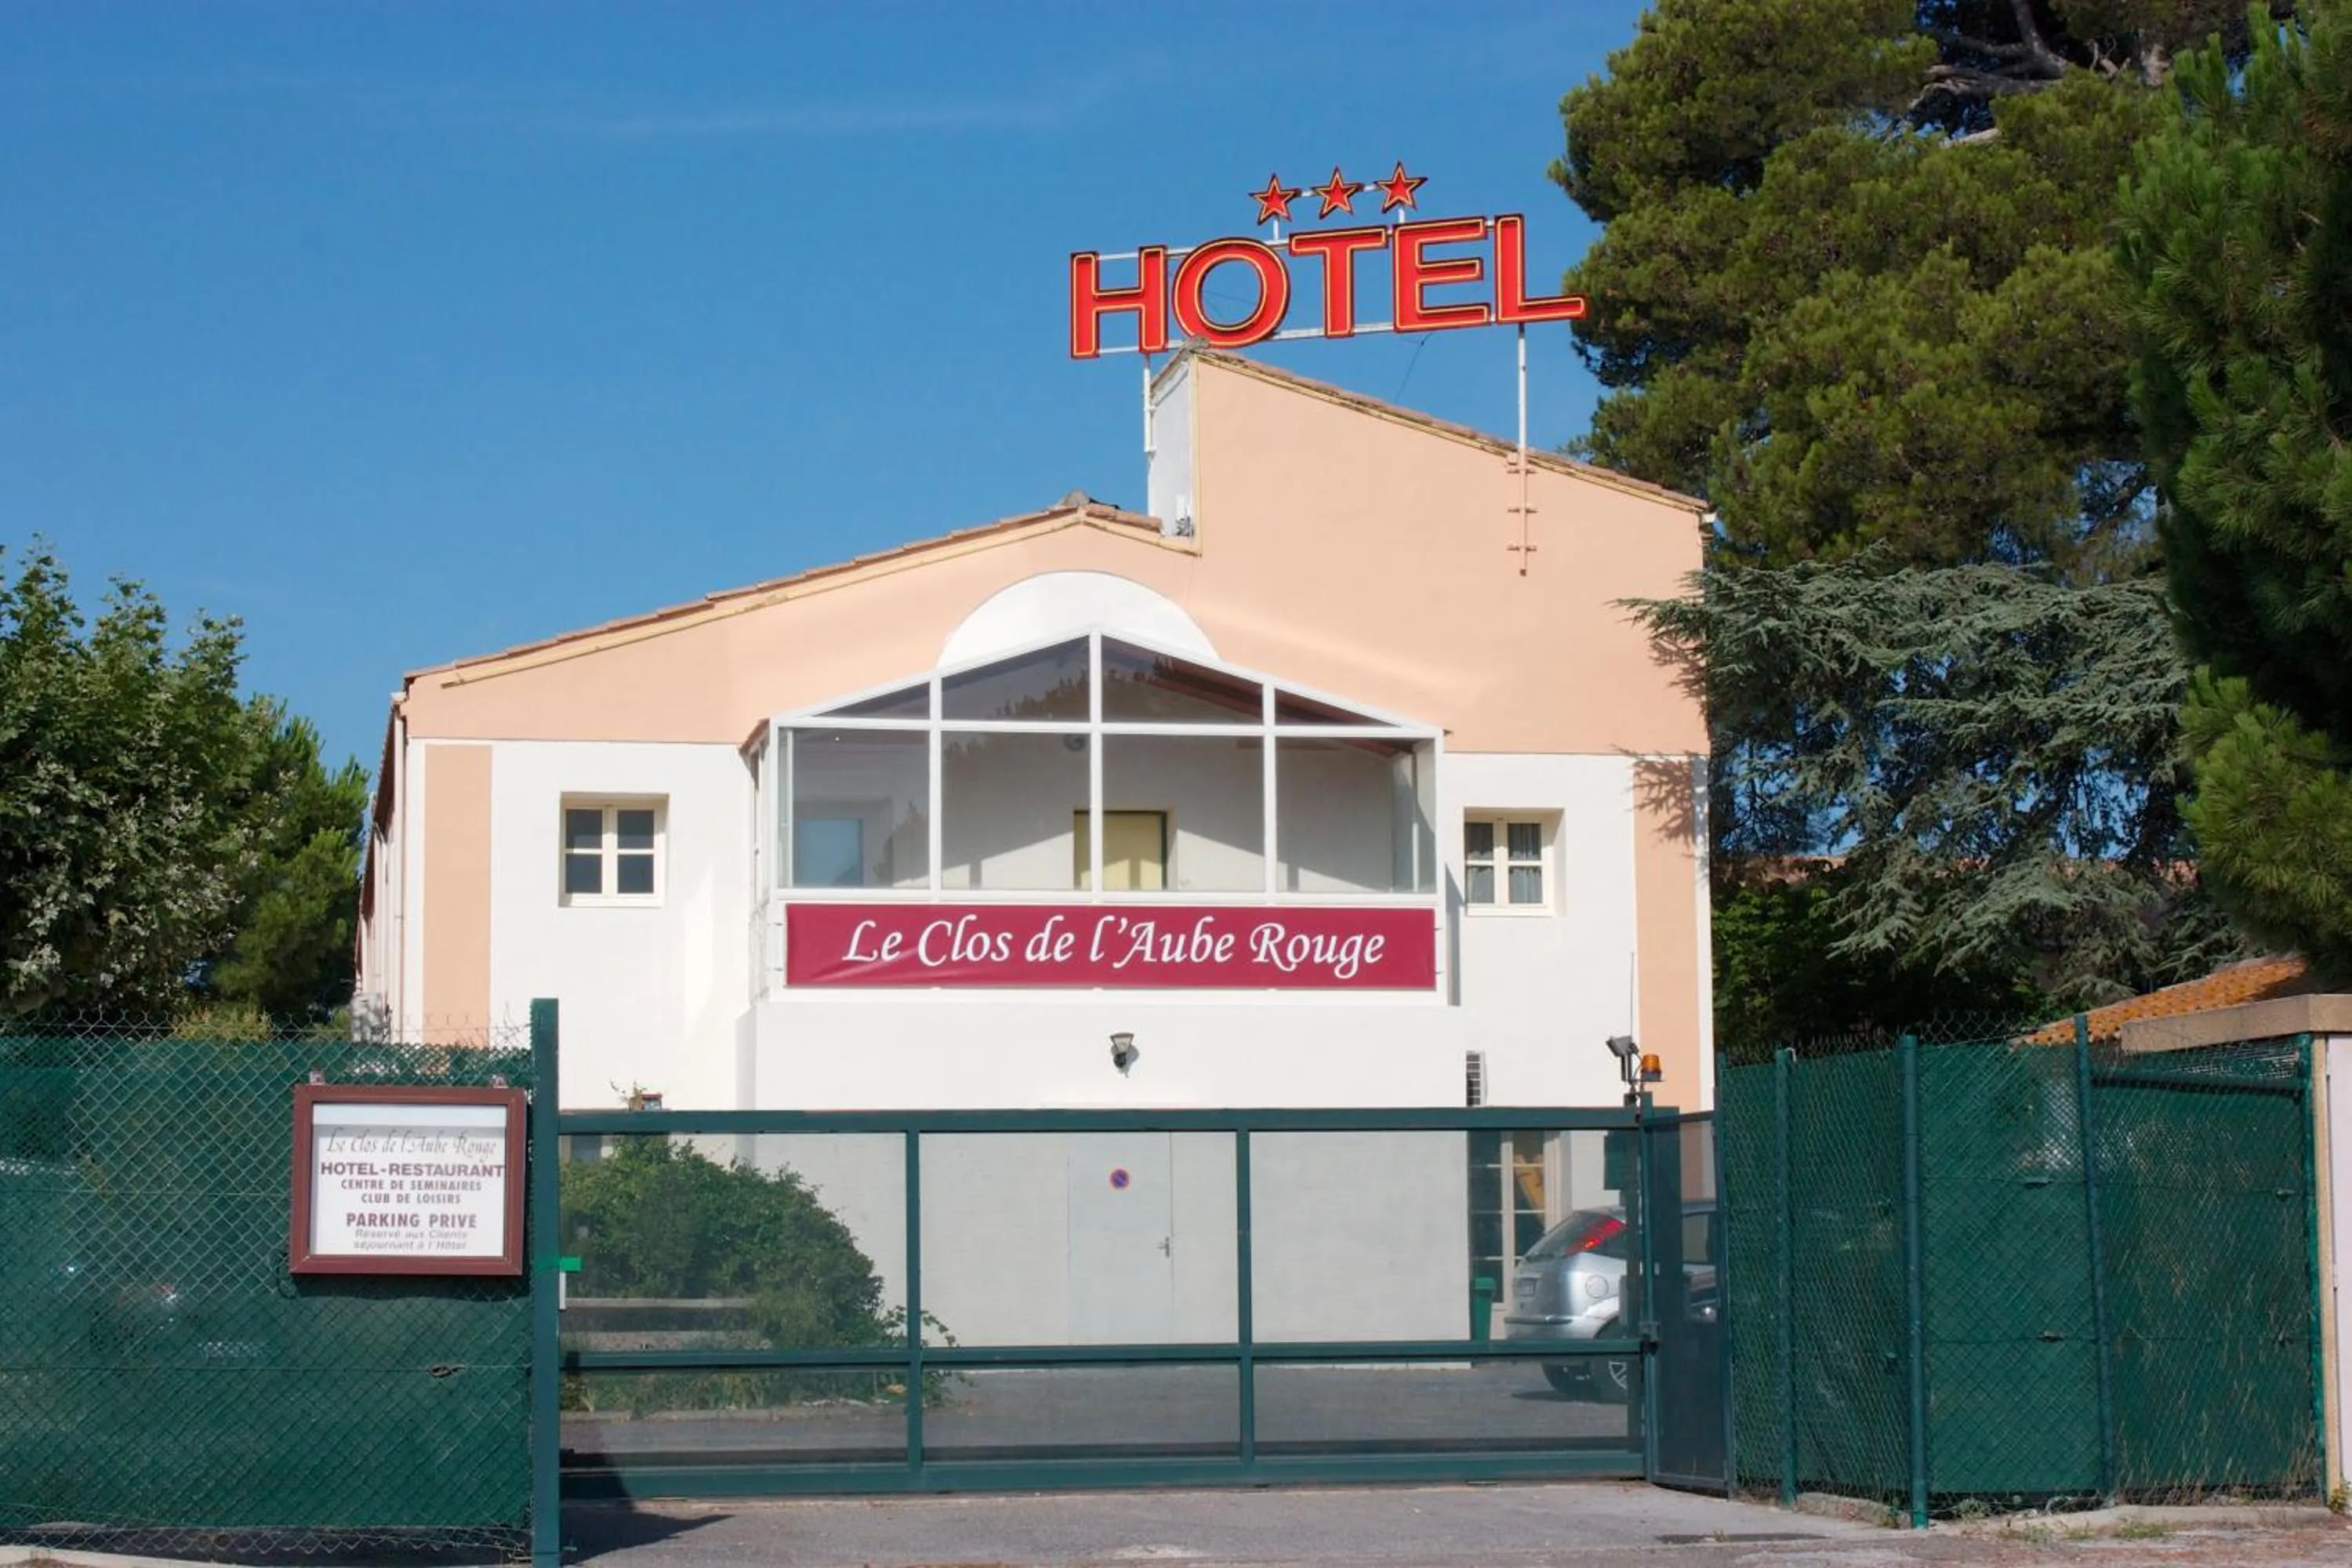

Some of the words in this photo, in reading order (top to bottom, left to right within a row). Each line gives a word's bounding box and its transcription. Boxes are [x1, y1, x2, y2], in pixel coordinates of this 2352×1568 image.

[1071, 213, 1587, 359] HOTEL
[842, 920, 903, 961] Le
[917, 913, 1013, 967] Clos
[1025, 915, 1075, 963] de
[1249, 922, 1385, 979] Rouge
[326, 1127, 346, 1152] Le
[382, 1129, 397, 1152] de
[452, 1130, 496, 1163] Rouge
[341, 1178, 384, 1189] CENTRE
[390, 1179, 405, 1190] DE
[410, 1180, 482, 1191] SEMINAIRES
[361, 1192, 390, 1203] CLUB
[396, 1193, 411, 1203] DE
[417, 1193, 461, 1204] LOISIRS
[347, 1213, 419, 1228] PARKING
[429, 1214, 477, 1229] PRIVE
